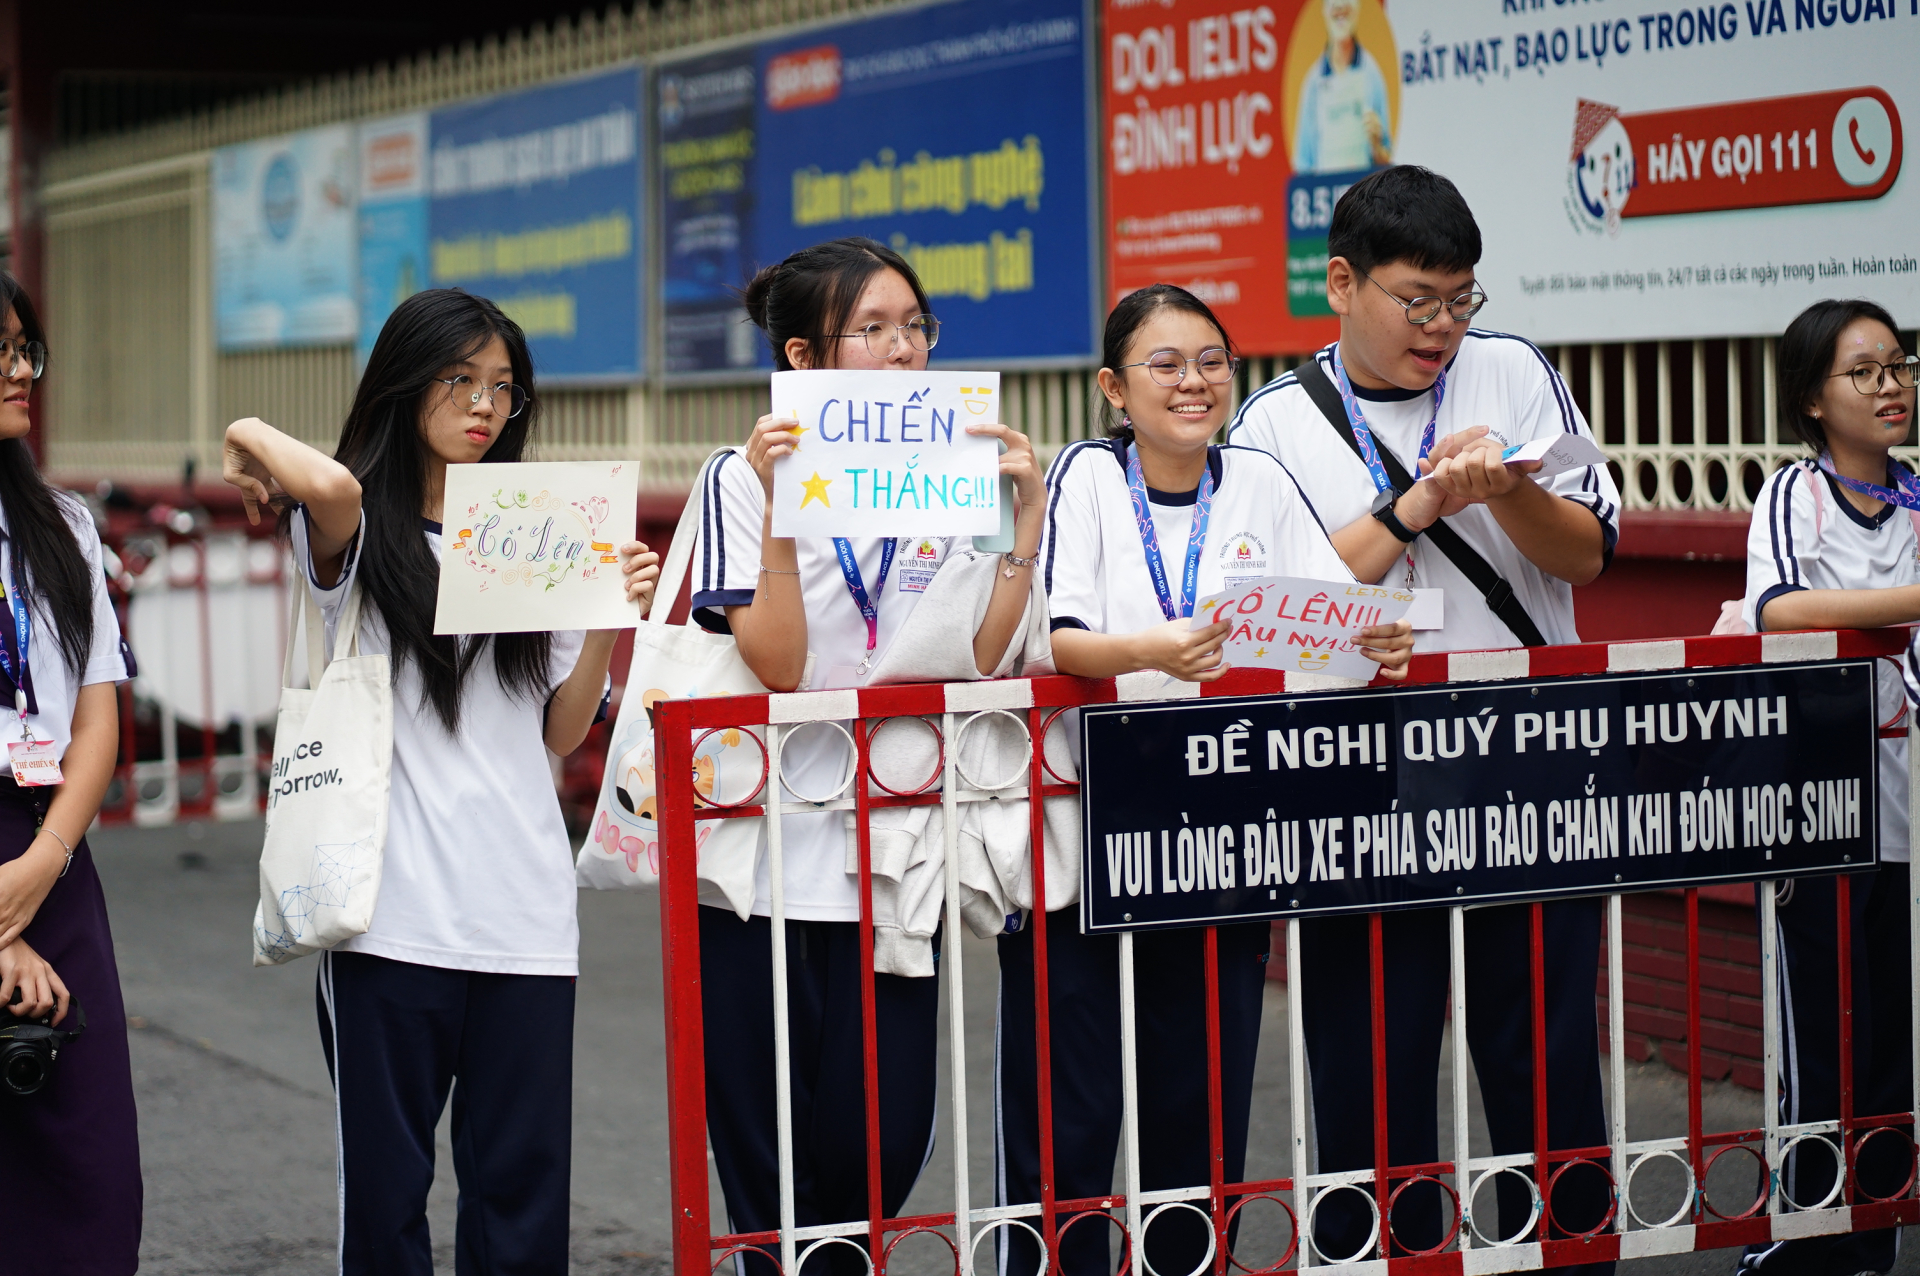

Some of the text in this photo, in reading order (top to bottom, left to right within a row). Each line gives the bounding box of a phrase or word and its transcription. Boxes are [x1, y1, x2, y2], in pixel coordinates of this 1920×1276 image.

[1112, 25, 1185, 95] DOL
[1188, 5, 1278, 81] IELTS
[1402, 30, 1446, 84] BẮT
[1454, 37, 1511, 85] NẠT,
[1515, 29, 1569, 78] BẠO
[1576, 18, 1631, 69] LỰC
[1638, 4, 1738, 52] TRONG
[1112, 90, 1273, 176] ĐÌNH LỰC
[1648, 128, 1818, 184] HÃY GỌI 111
[1291, 186, 1331, 230] 8.5
[1667, 266, 1693, 290] 24/7
[1751, 260, 1780, 288] ngày
[1782, 261, 1815, 285] trong
[1852, 254, 1885, 277] Hoàn
[1889, 252, 1918, 277] toàn
[818, 386, 956, 447] CHIẾN
[844, 453, 995, 510] THẮNG!!!
[474, 514, 585, 562] Cố Lên
[1212, 583, 1276, 625] CỐ
[1345, 586, 1416, 603] LETS GO
[1184, 695, 1788, 777] ĐỀ NGHỊ QUÝ PHỤ HUYNH
[1105, 773, 1861, 901] VUI LÒNG ĐẬU XE PHÍA SAU RÀO CHẮN KHI ĐÓN HỌC SINH
